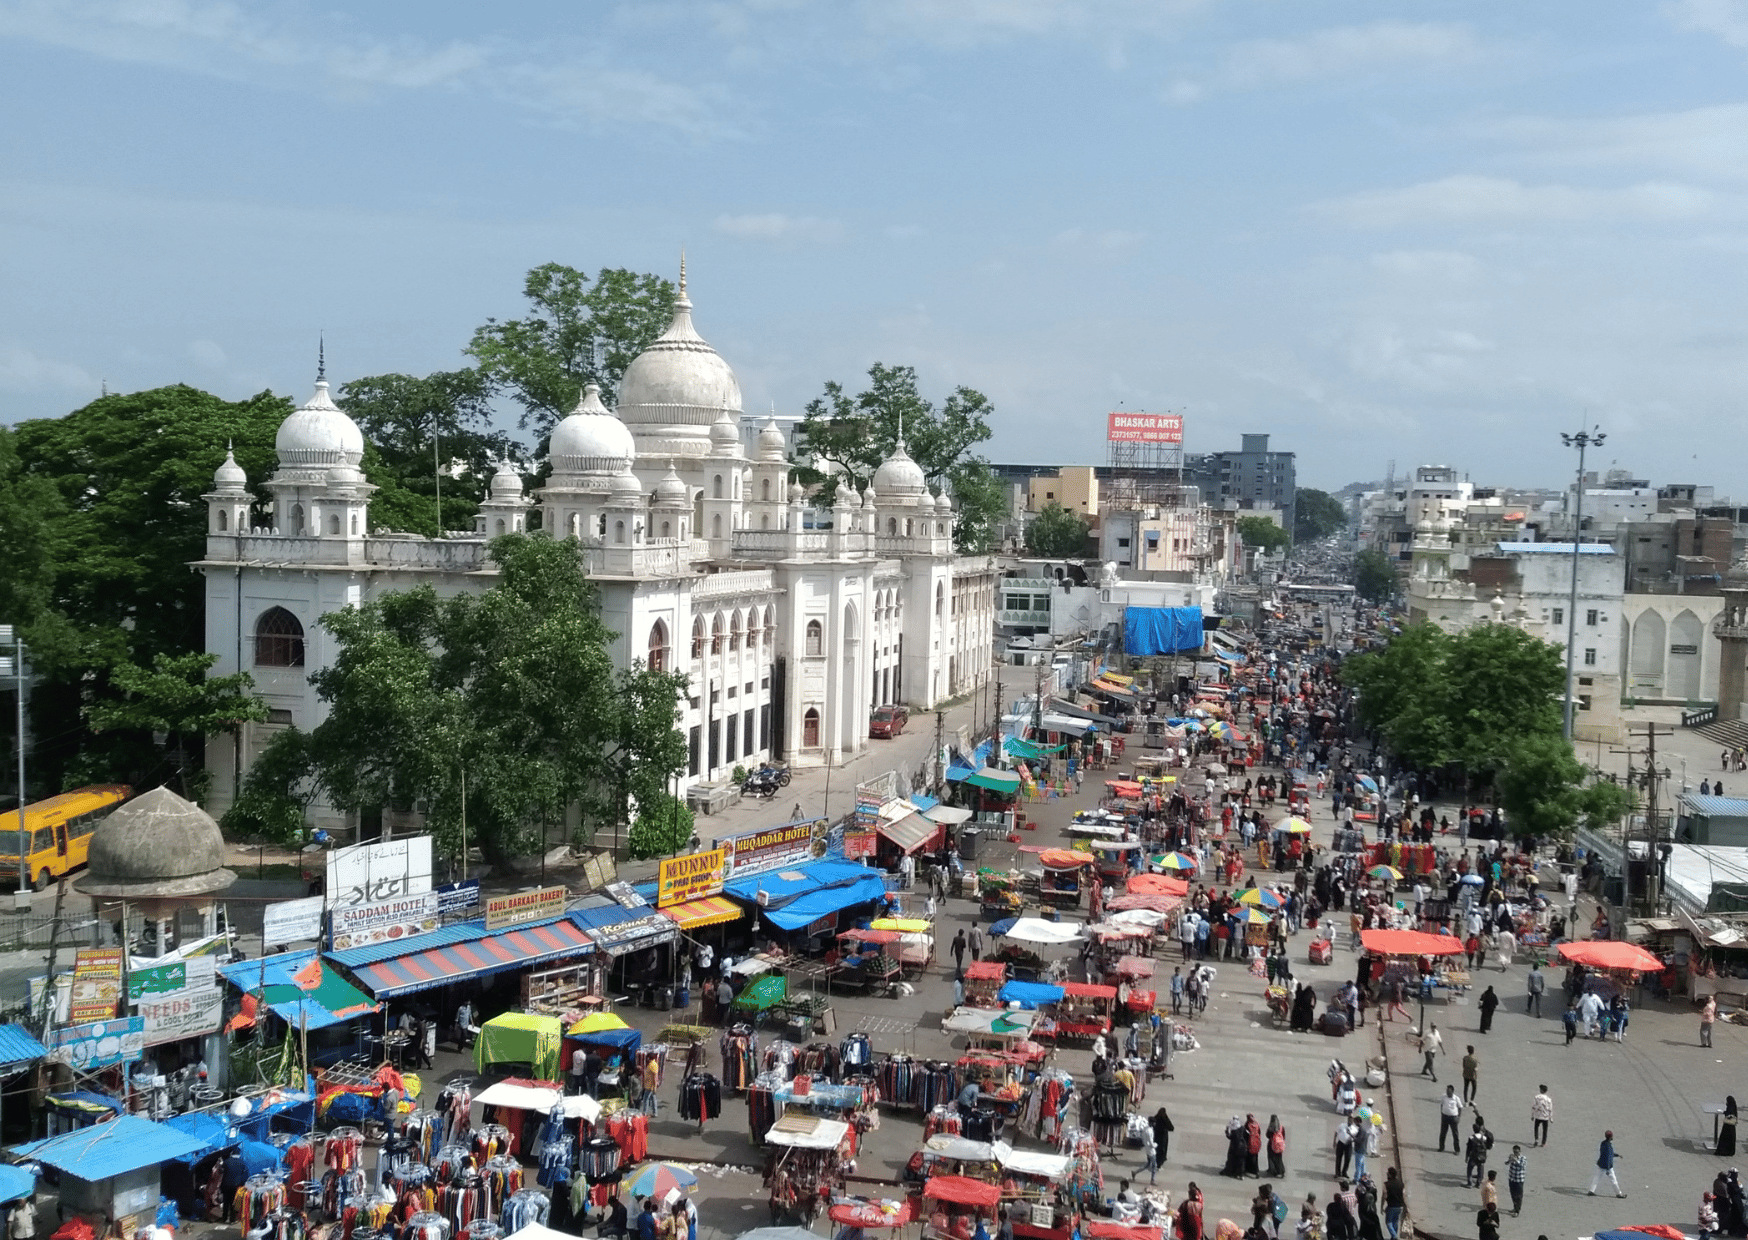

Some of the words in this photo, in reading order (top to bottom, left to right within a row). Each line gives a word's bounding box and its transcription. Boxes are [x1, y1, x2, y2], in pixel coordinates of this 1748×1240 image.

[1114, 417, 1155, 428] BHASKAR
[1157, 418, 1179, 429] ARTS
[736, 832, 784, 851] MUQADDAR
[784, 826, 810, 841] HOTEL
[666, 853, 719, 878] MUNNU
[343, 904, 389, 922] SADDAM
[393, 898, 427, 915] HOTEL
[489, 902, 507, 912] ABUL
[508, 894, 538, 908] BARKAAT
[540, 889, 564, 901] BAKERY
[142, 998, 191, 1020] NEEDS
[163, 1016, 181, 1026] COOL
